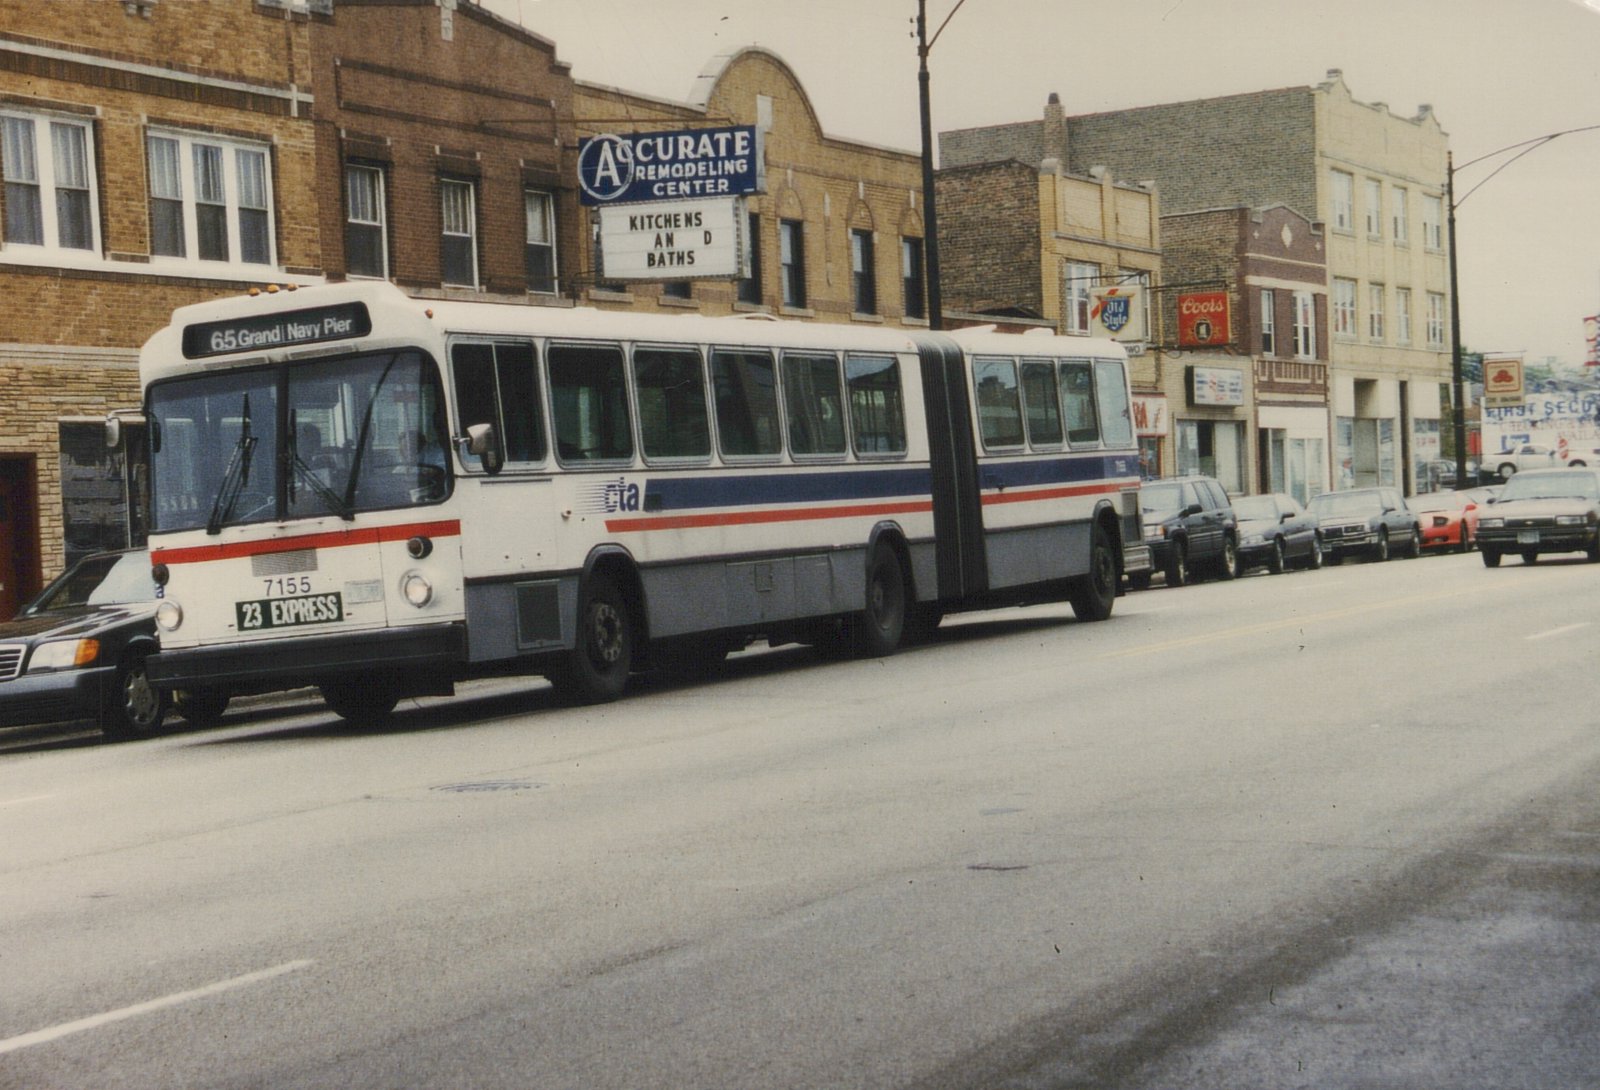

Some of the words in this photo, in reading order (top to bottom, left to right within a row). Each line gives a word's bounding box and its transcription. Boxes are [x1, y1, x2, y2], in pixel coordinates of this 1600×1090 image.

[593, 131, 751, 188] ACCURATE
[635, 159, 748, 181] REMODELING
[653, 179, 729, 196] CENTER
[629, 212, 703, 231] KITCHENS
[647, 251, 695, 267] BATHS
[1107, 301, 1125, 314] Old
[211, 331, 236, 351] 65
[238, 325, 281, 347] Grand
[287, 322, 320, 339] Navy
[324, 318, 352, 335] Pier
[264, 576, 311, 597] 7155
[243, 603, 263, 628] 23
[271, 596, 340, 626] EXPRESS
